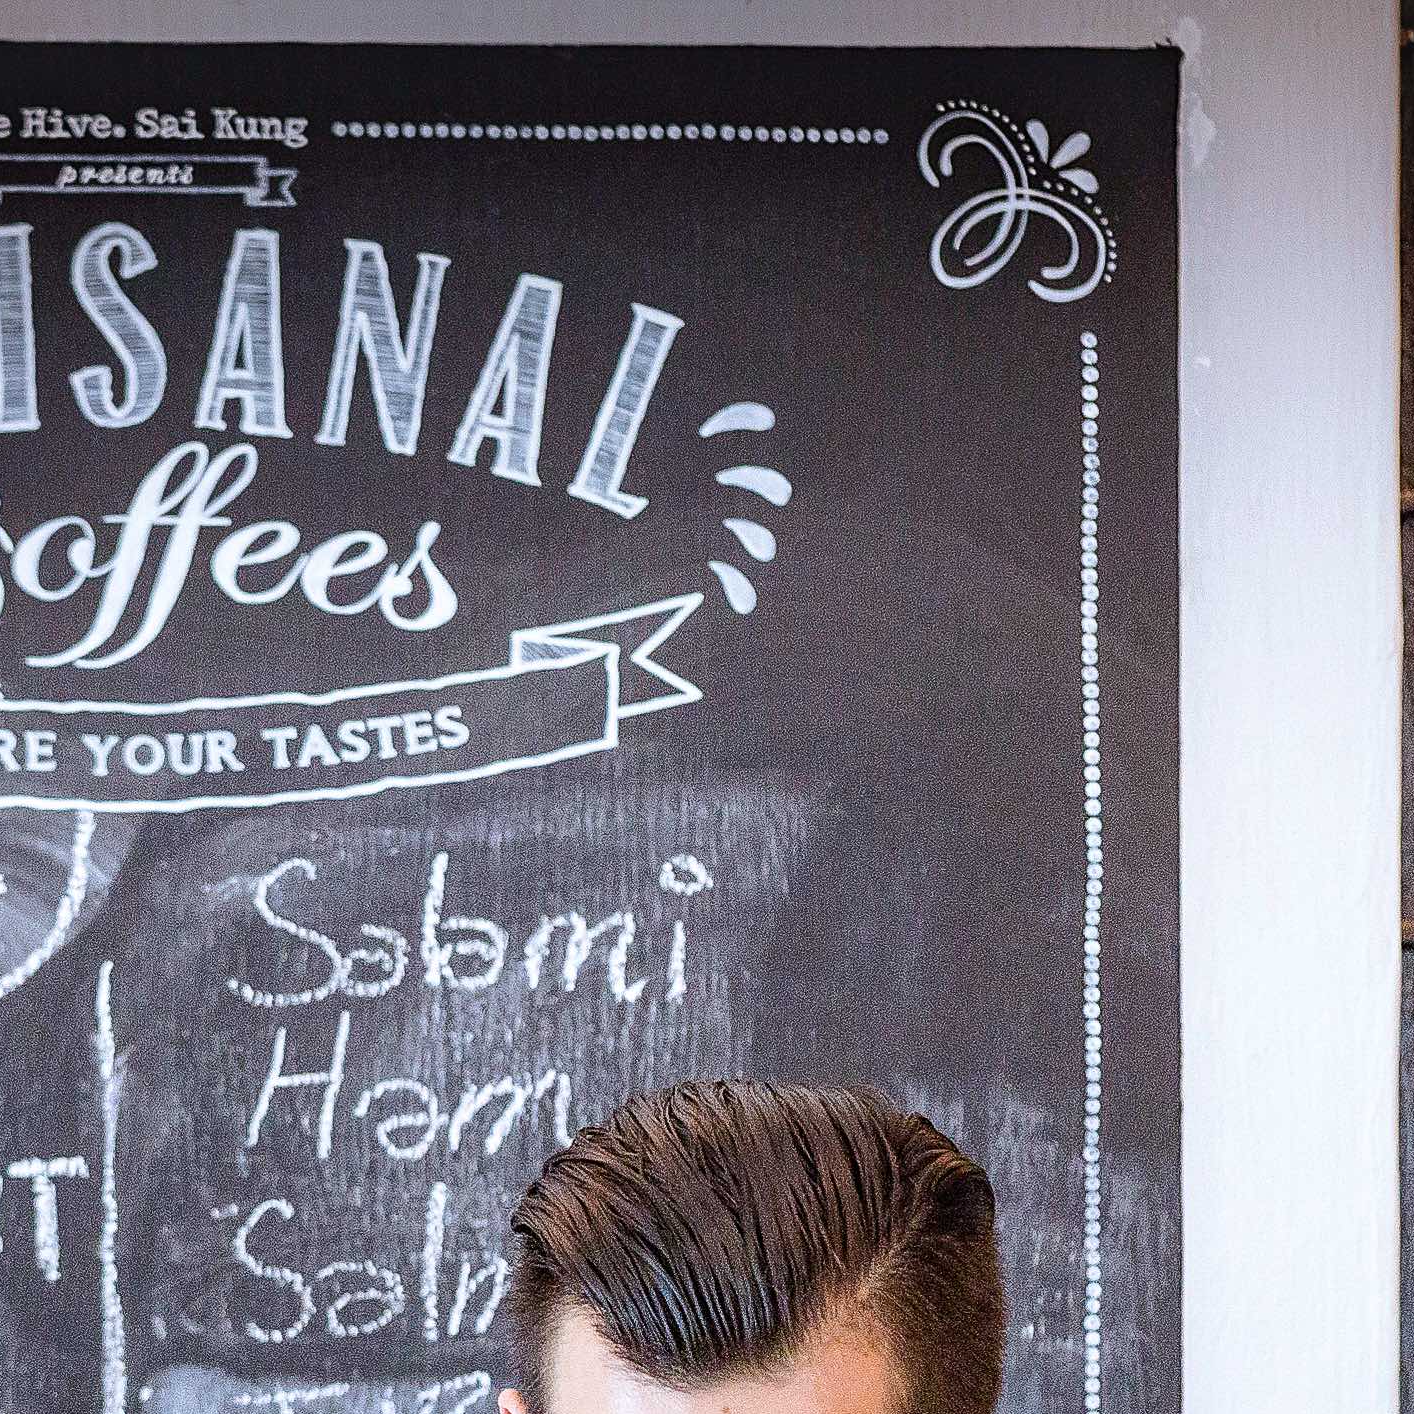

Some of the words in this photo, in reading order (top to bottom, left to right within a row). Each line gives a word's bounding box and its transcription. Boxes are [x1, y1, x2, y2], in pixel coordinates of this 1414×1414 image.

[135, 107, 205, 139] Sai
[211, 107, 309, 148] Kung
[55, 164, 193, 189] presents
[83, 722, 246, 776] YOUR
[270, 705, 470, 772] TASTES
[246, 1010, 574, 1160] Ham
